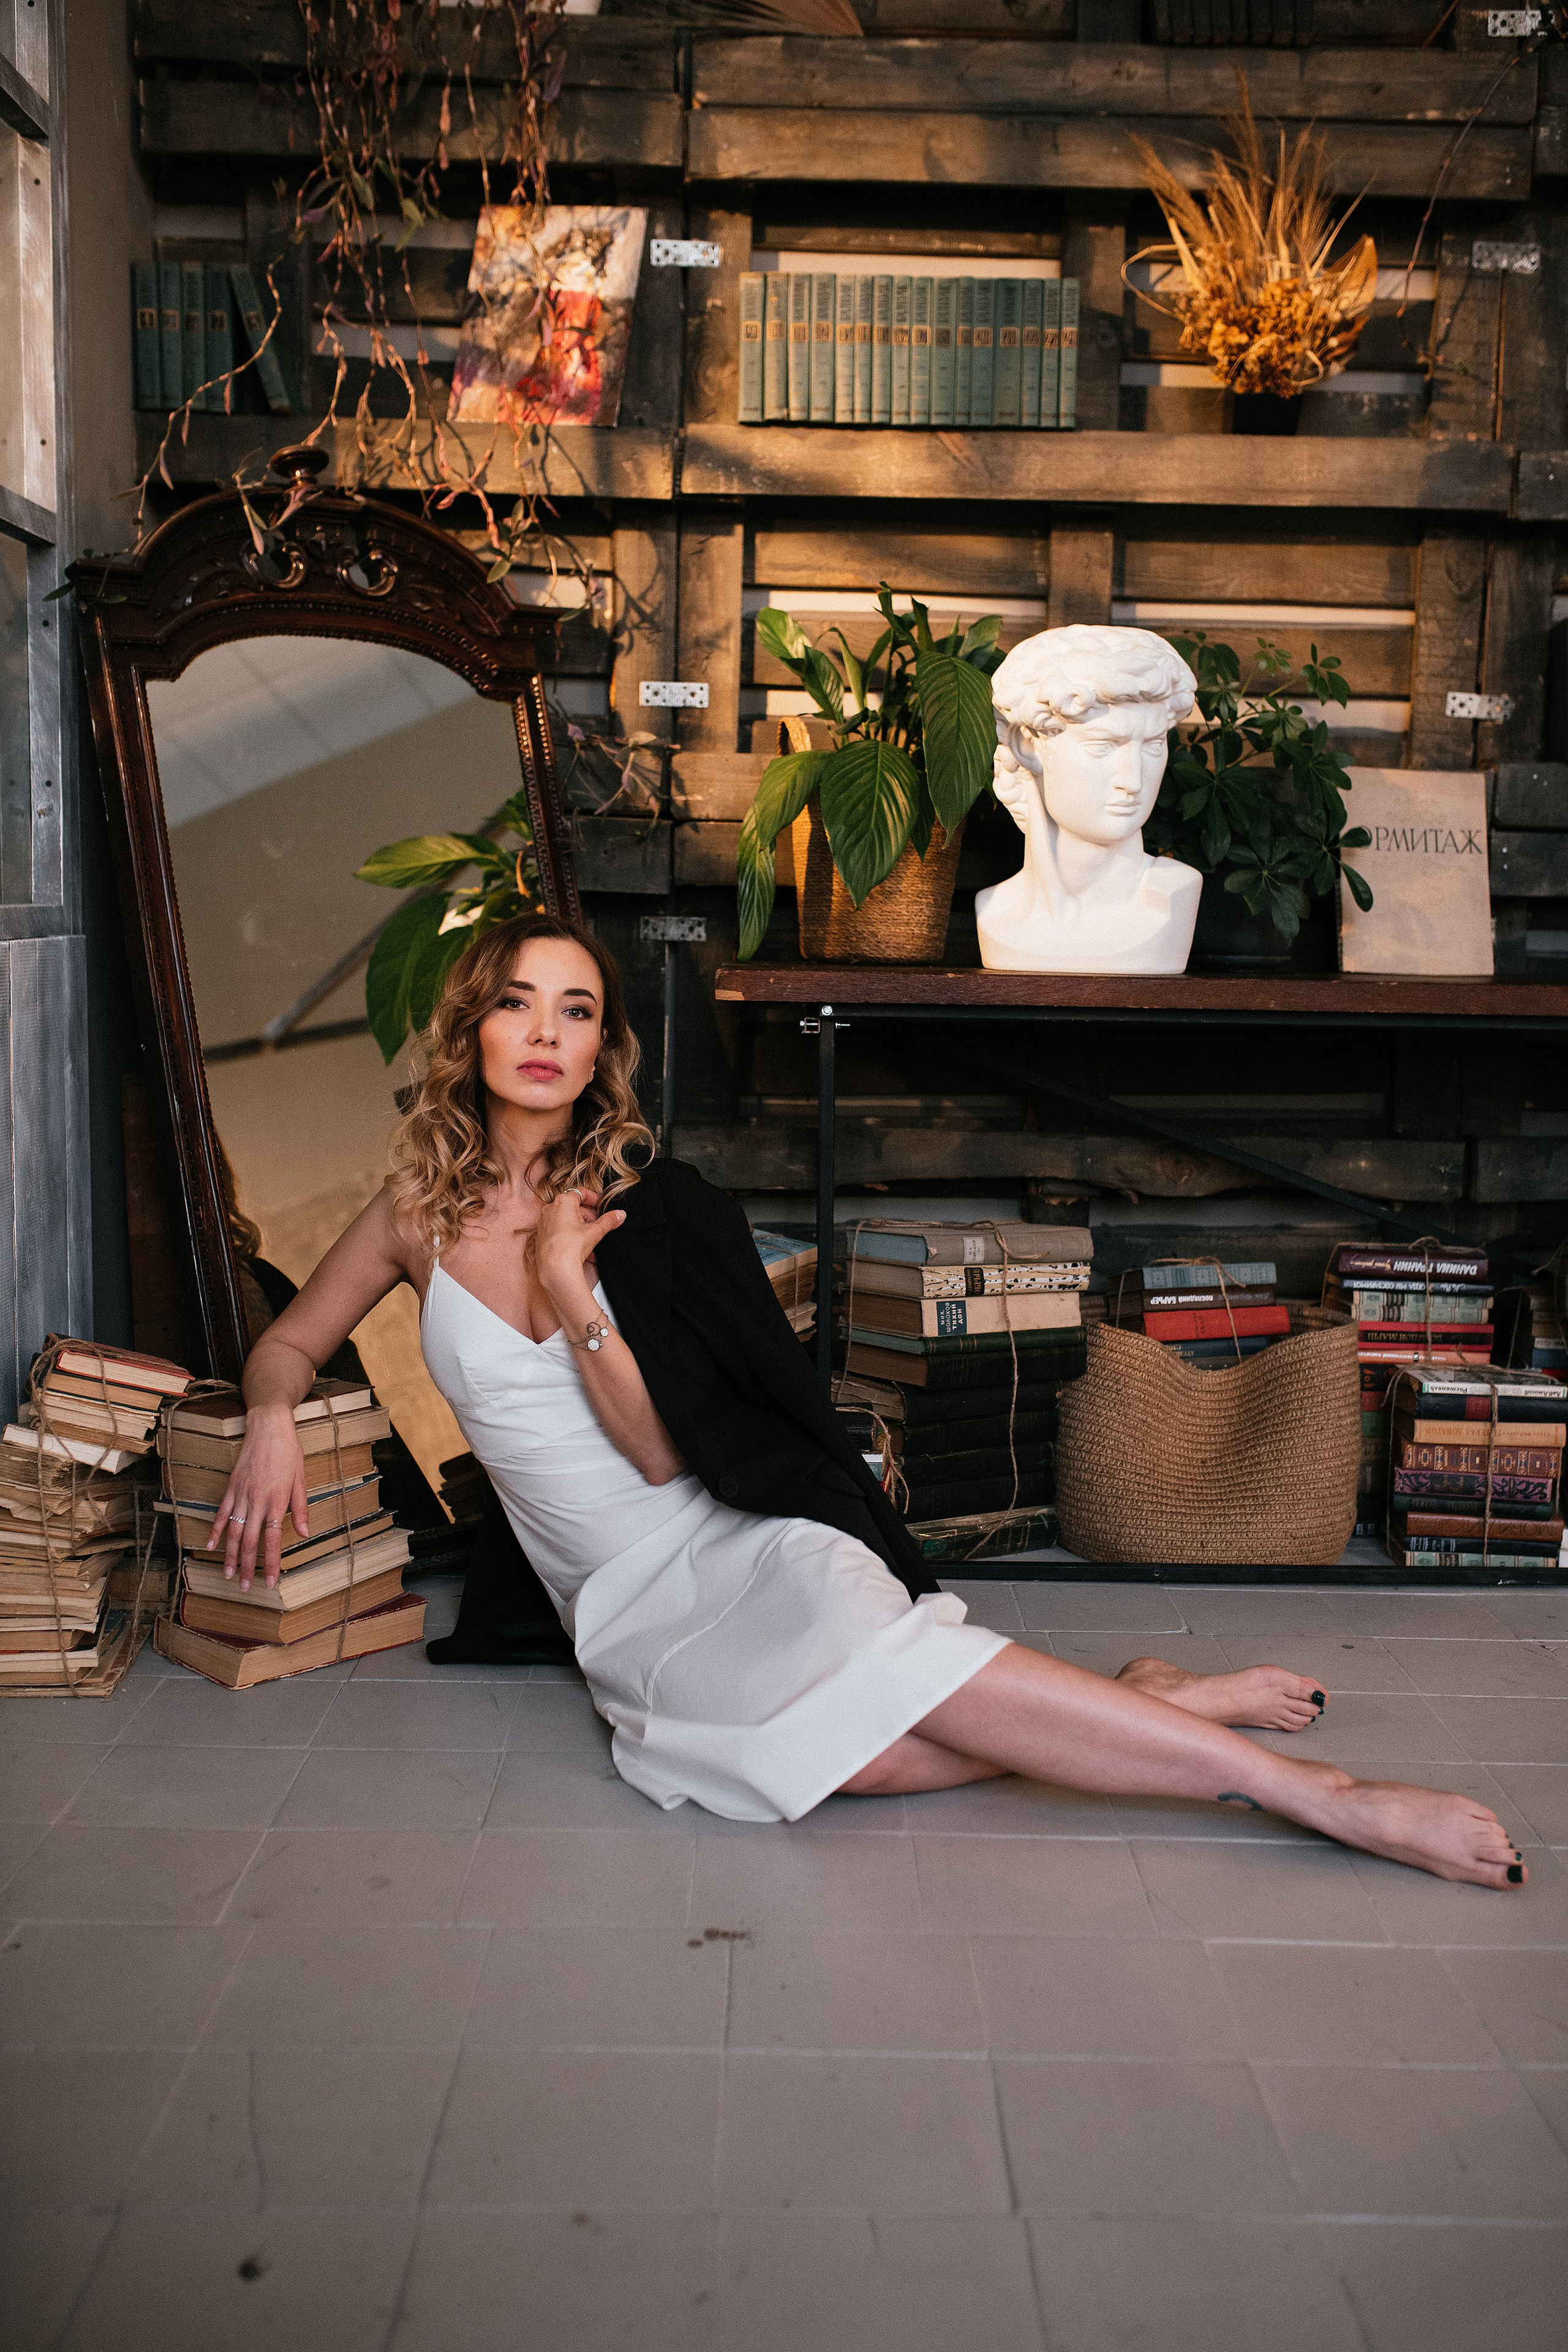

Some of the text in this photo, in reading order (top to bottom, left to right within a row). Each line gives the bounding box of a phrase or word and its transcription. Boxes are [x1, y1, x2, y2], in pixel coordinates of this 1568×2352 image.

[1357, 825, 1483, 854] РМИТАЖ
[1150, 1295, 1177, 1305] БАРЬЕР
[1400, 1333, 1442, 1342] БОЬШОЙ
